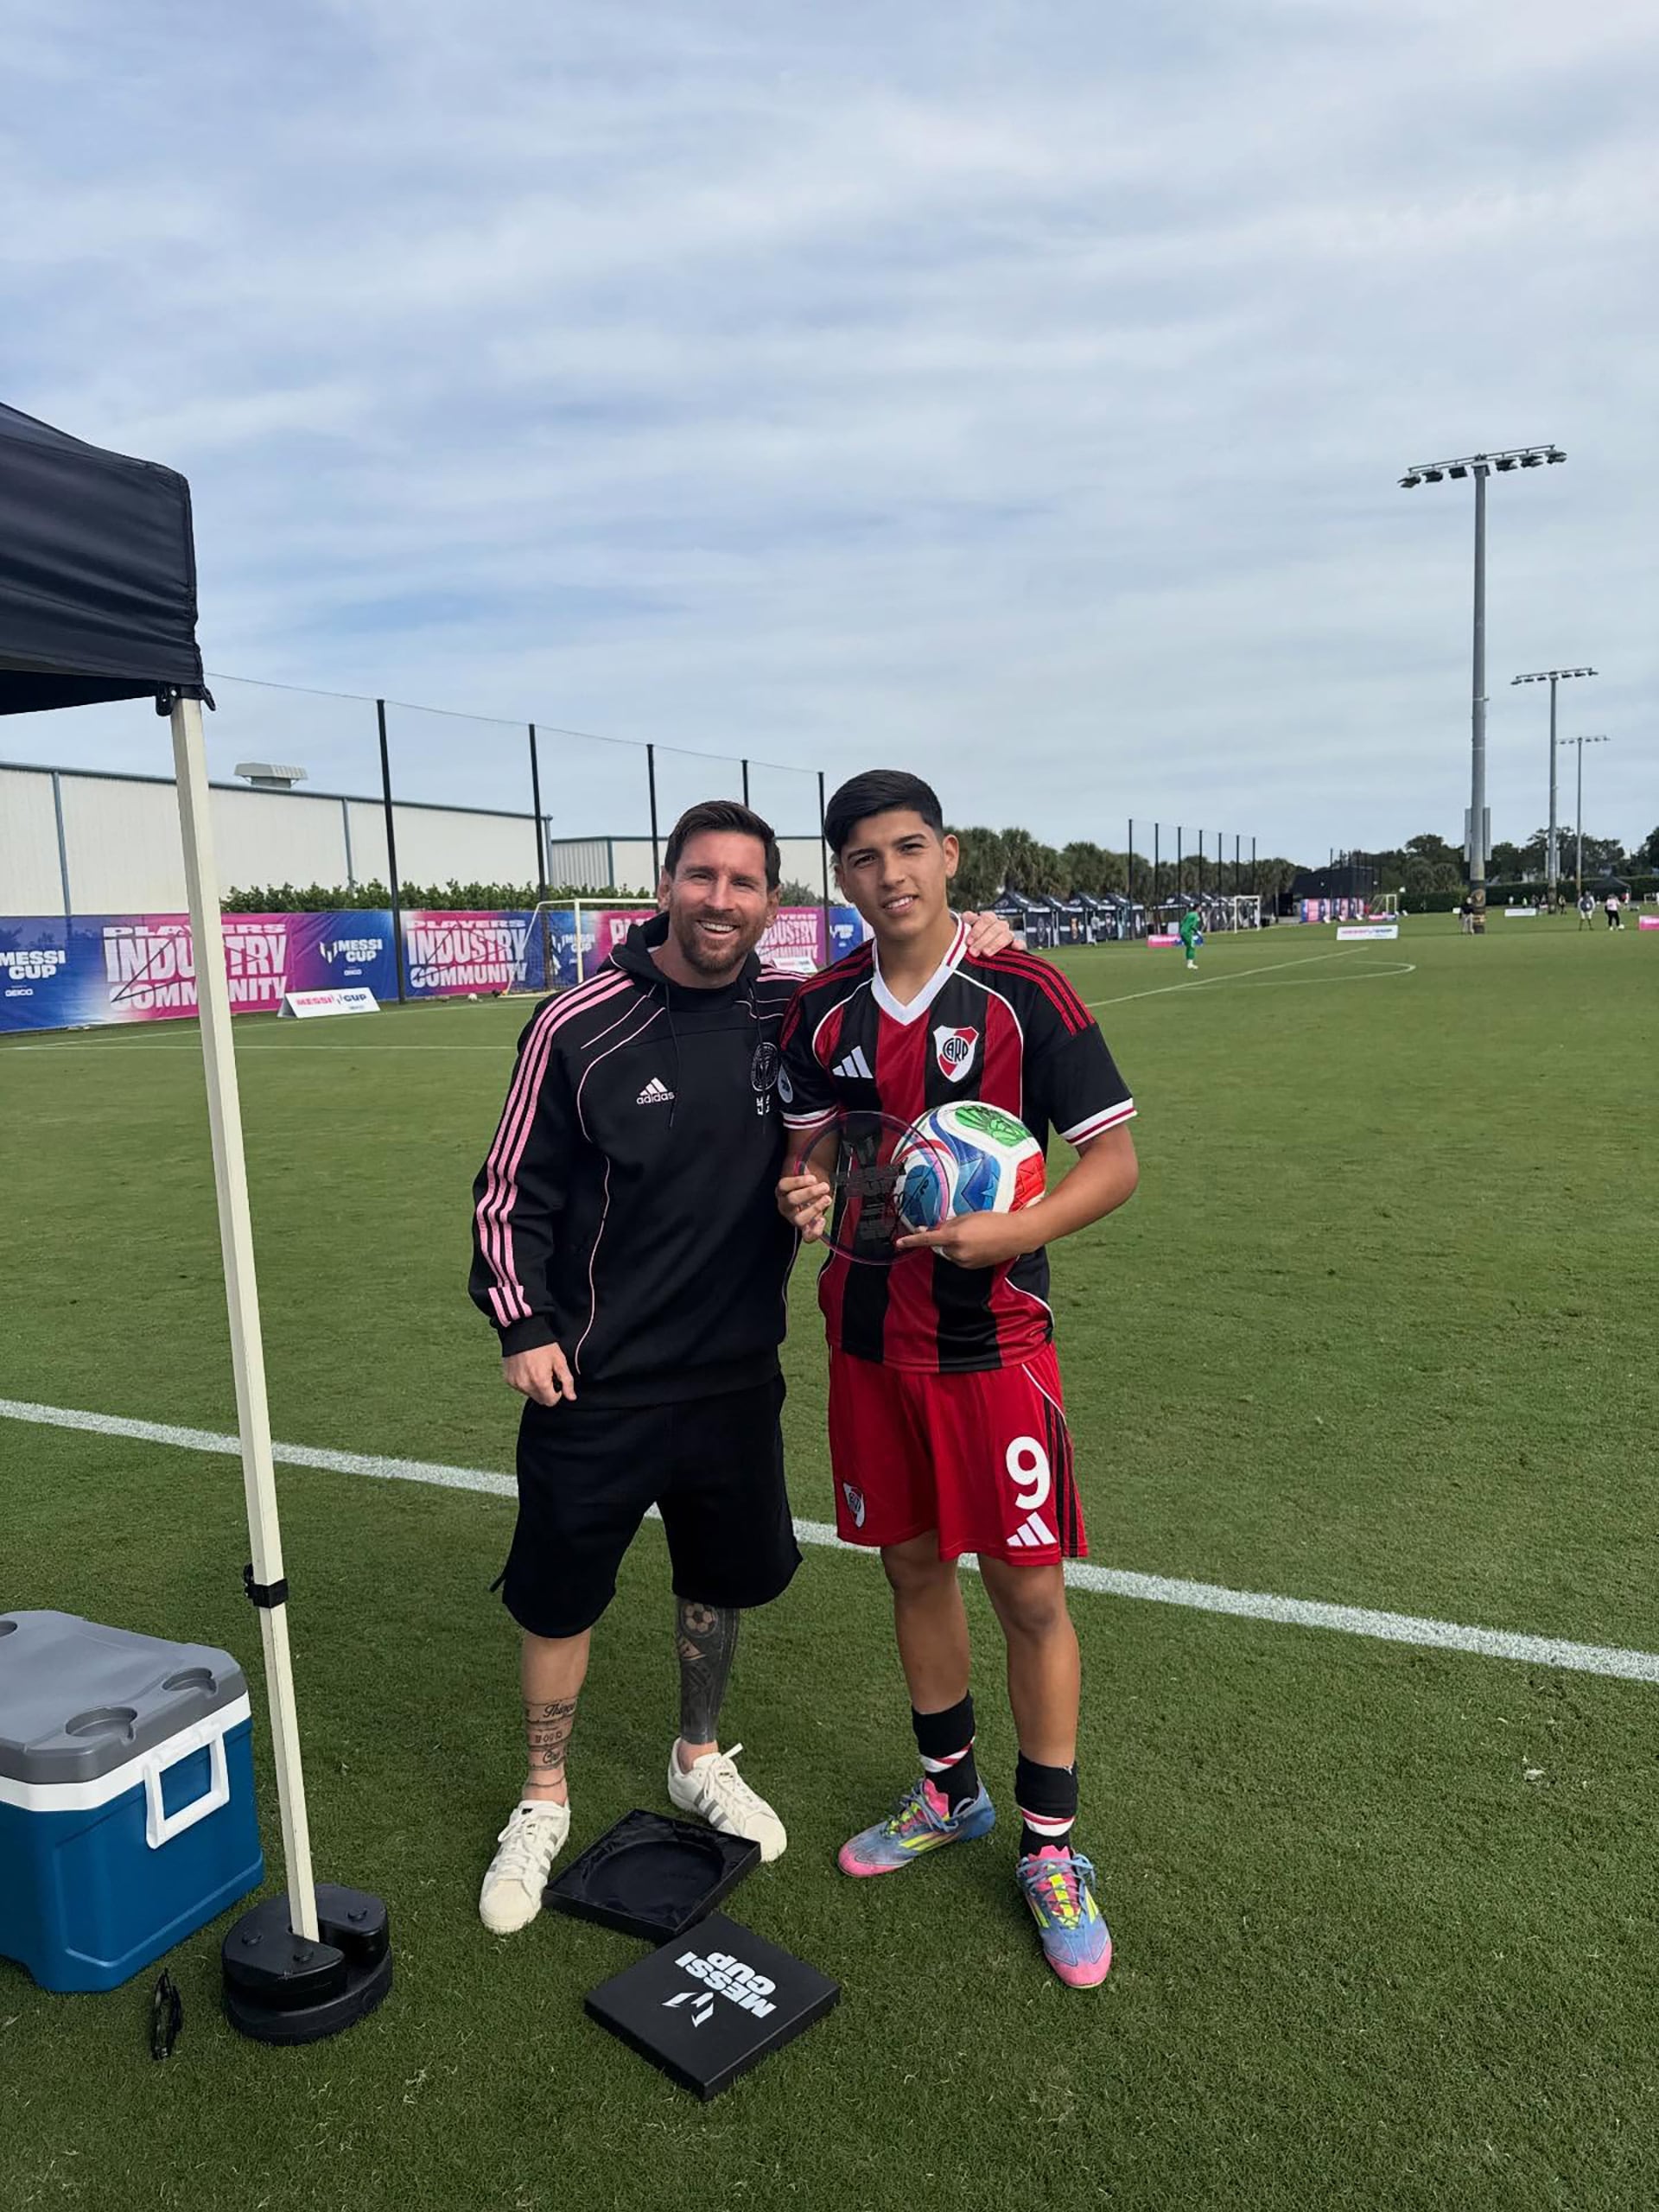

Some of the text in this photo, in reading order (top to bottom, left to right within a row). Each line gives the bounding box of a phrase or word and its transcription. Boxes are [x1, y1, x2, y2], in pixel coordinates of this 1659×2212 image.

[406, 919, 526, 930] PLAYERS
[338, 938, 383, 951] MESSI
[407, 929, 527, 966] INDUSTRY
[0, 950, 67, 966] MESSI
[104, 934, 287, 982] INDUTRY
[346, 950, 378, 963] CUP
[9, 964, 57, 980] CUP
[410, 962, 528, 988] COMMUNITY
[109, 976, 288, 1011] COMMNITY
[343, 993, 367, 1002] CUP
[636, 1090, 676, 1105] adidas
[1005, 1435, 1052, 1510] 9
[674, 1951, 778, 2018] MESSI
[706, 1952, 777, 1996] CUP
